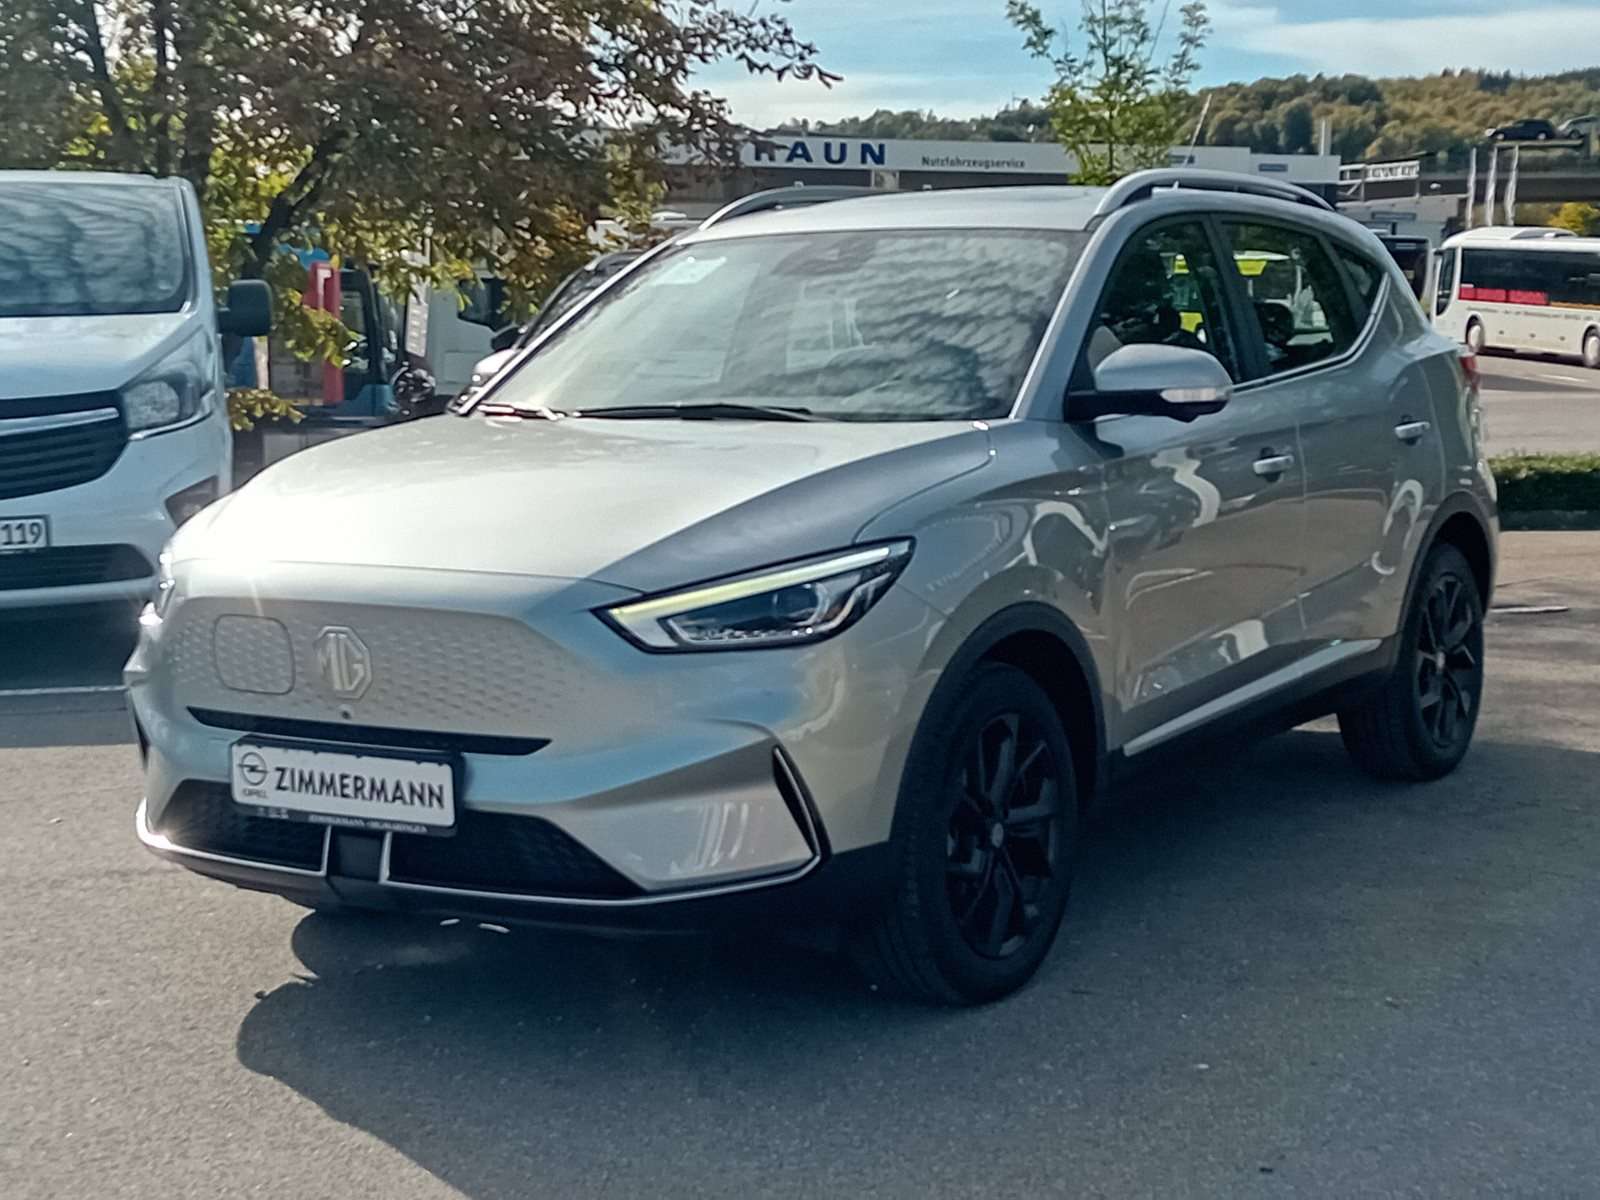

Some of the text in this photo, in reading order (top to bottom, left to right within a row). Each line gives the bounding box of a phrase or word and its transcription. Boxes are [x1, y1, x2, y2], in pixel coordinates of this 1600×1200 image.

[921, 155, 1026, 169] Nutzfahrzeugservice
[0, 522, 43, 546] 119
[317, 630, 368, 693] MG
[274, 766, 445, 810] ZIMMERMANN
